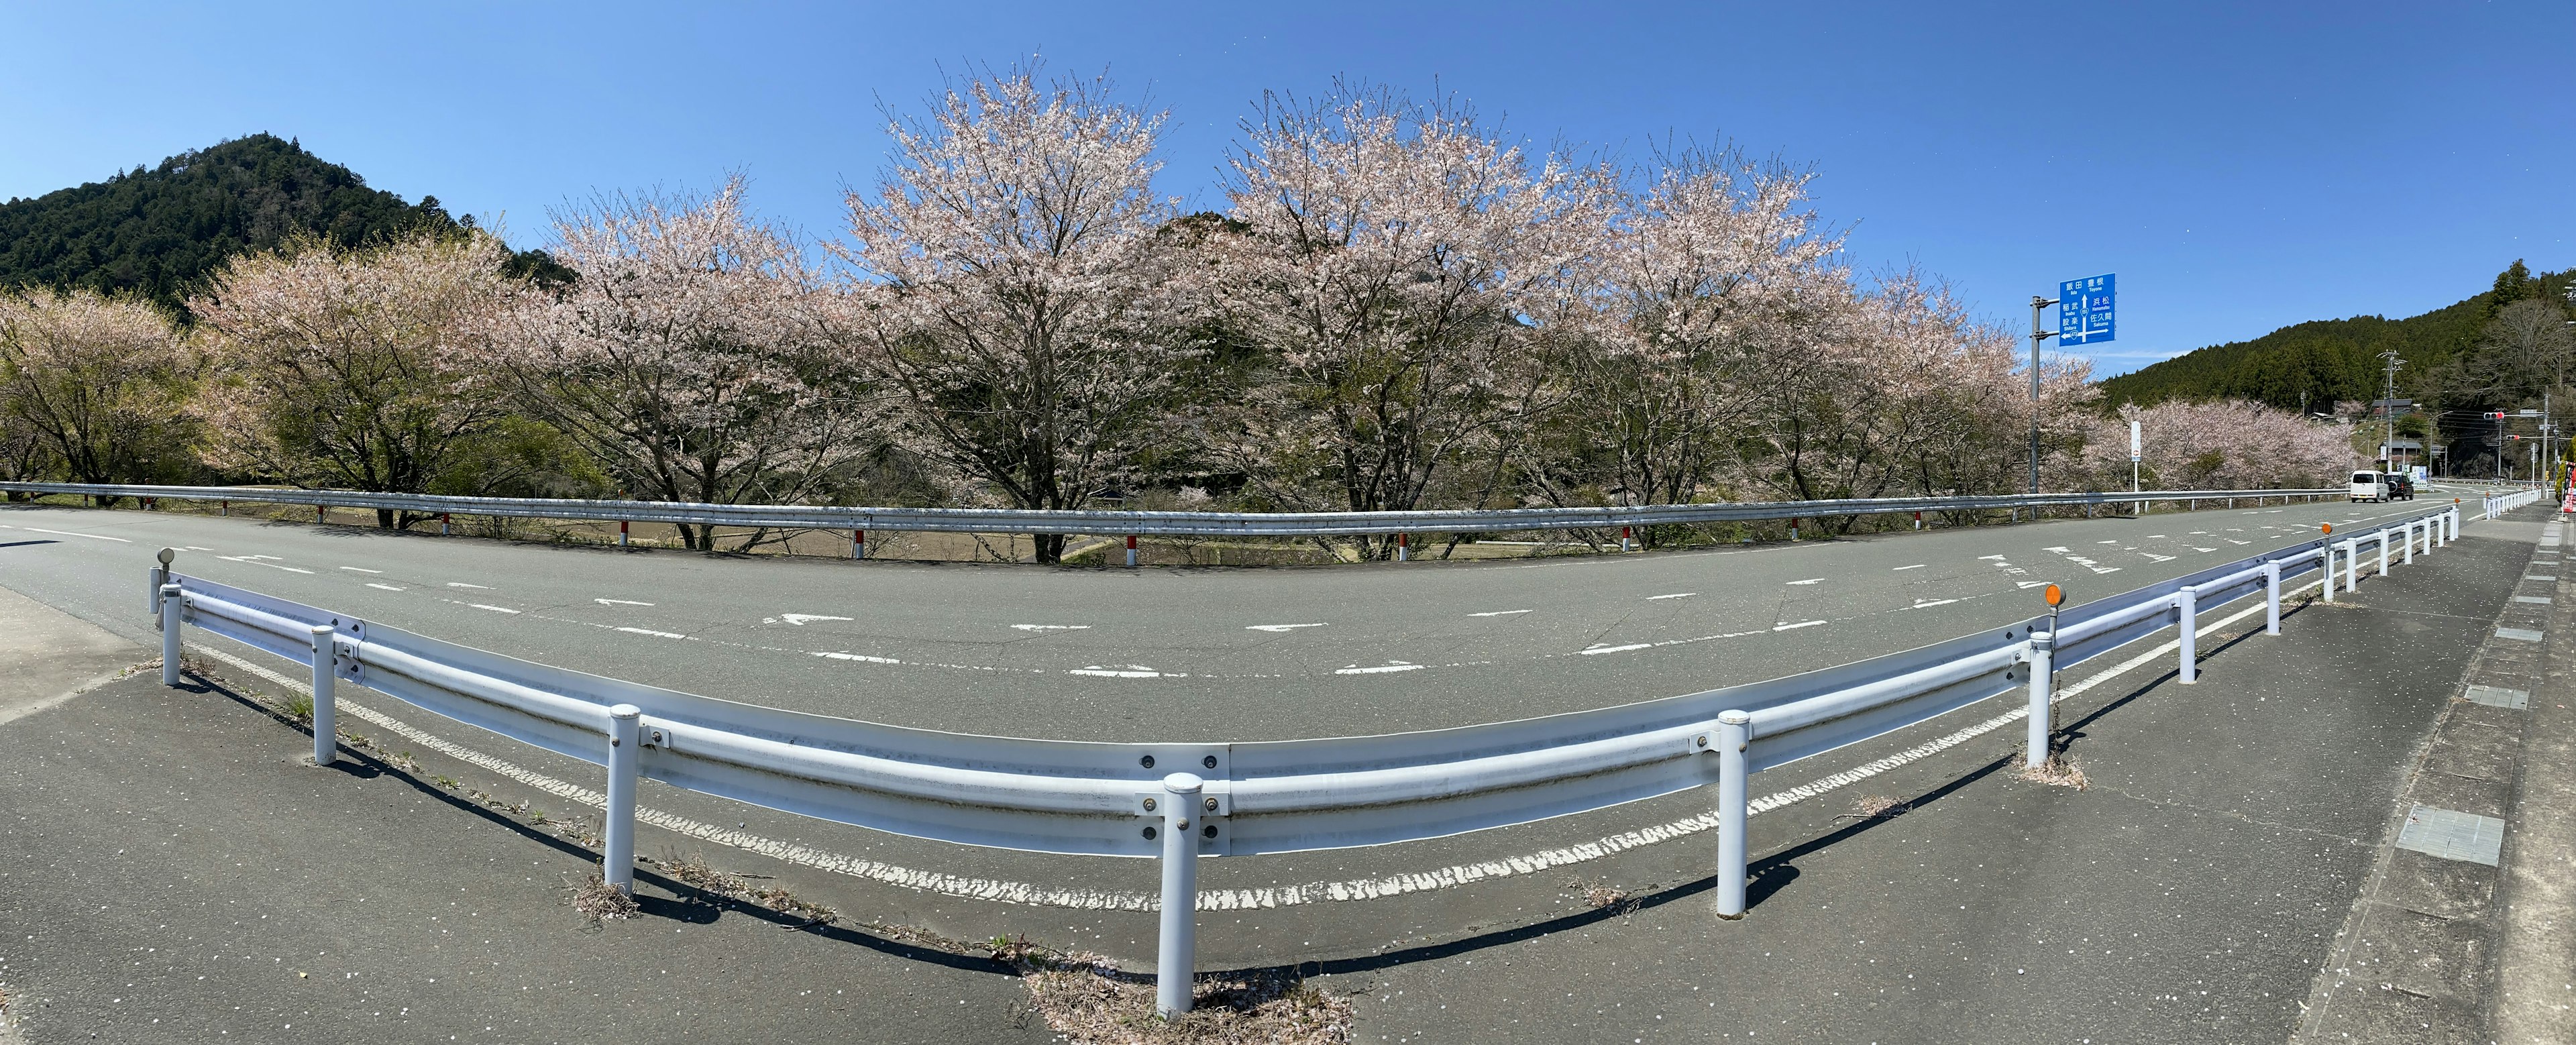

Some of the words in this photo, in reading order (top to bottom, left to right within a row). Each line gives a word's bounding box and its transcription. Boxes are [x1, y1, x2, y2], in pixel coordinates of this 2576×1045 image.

[2066, 281, 2082, 290] 飯田
[2088, 278, 2104, 287] 豊根
[2093, 296, 2110, 306] 浜松
[2063, 302, 2078, 311] 稲武
[2063, 317, 2078, 326] 設楽
[2090, 313, 2112, 322] 佐久間
